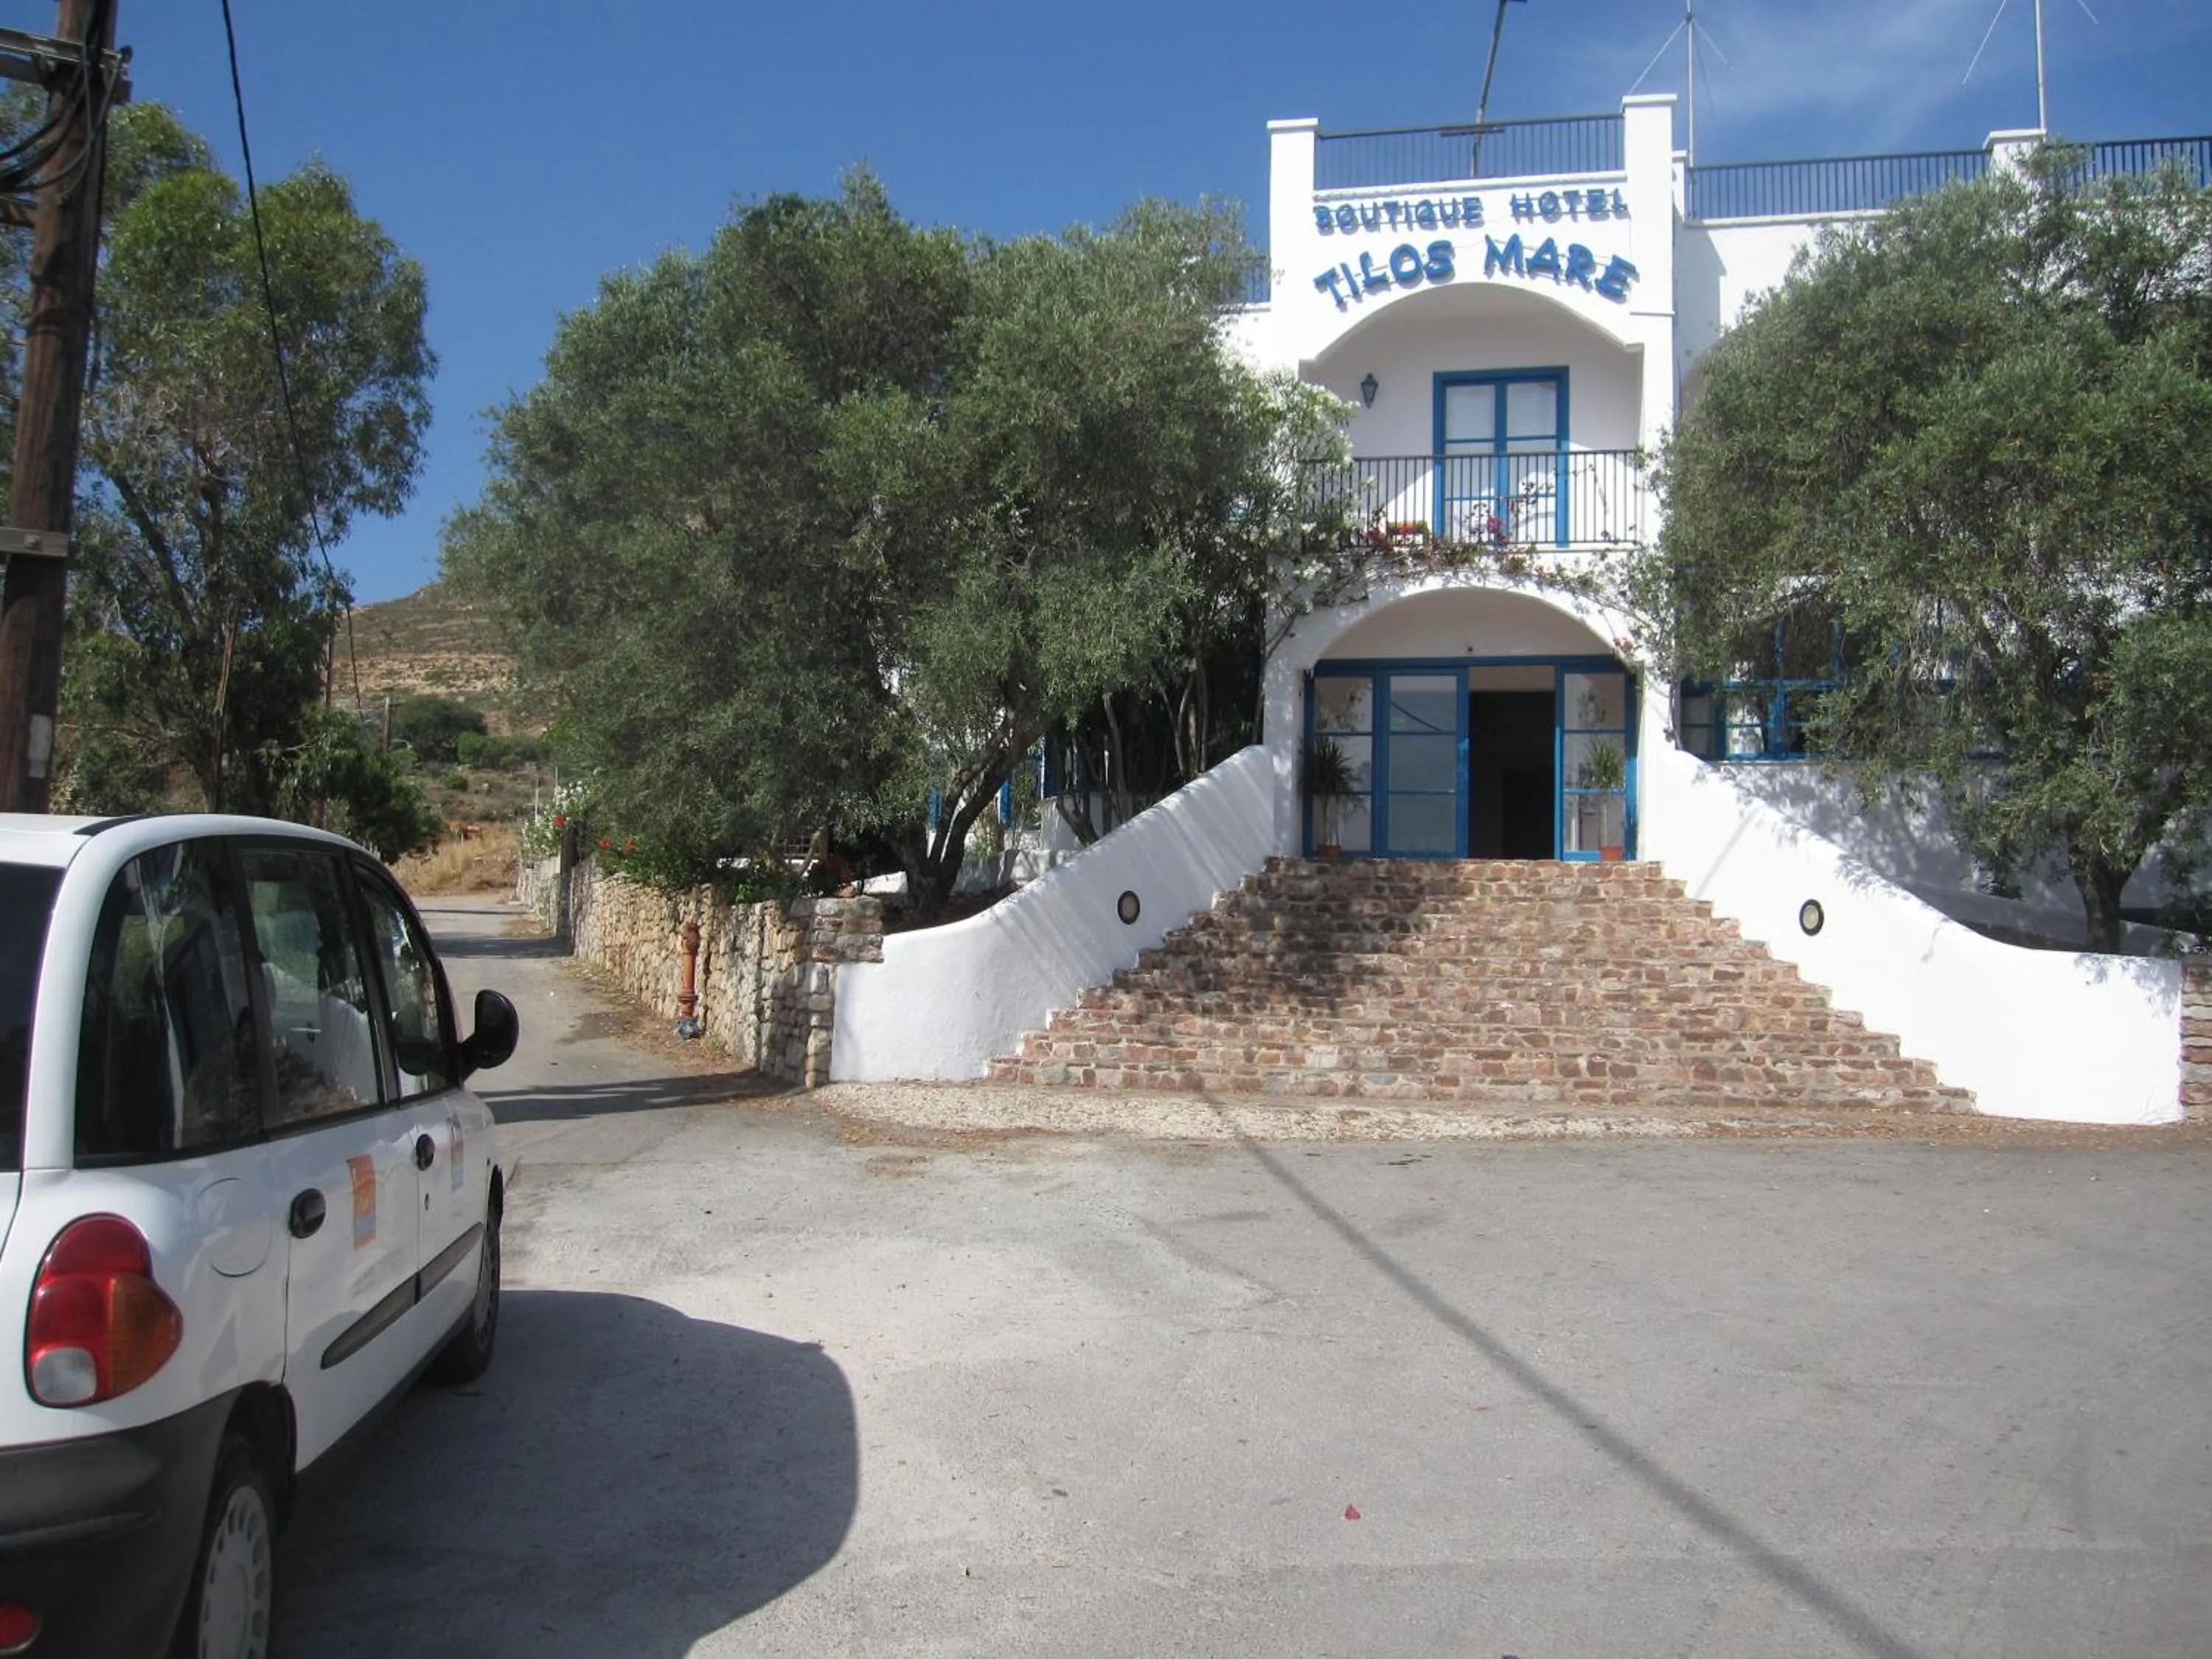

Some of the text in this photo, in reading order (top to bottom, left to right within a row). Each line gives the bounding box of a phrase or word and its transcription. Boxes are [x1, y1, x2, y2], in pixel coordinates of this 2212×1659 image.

[1313, 189, 1627, 233] BOUTIQUE HOTEL
[1314, 234, 1638, 307] TILOS MARE
